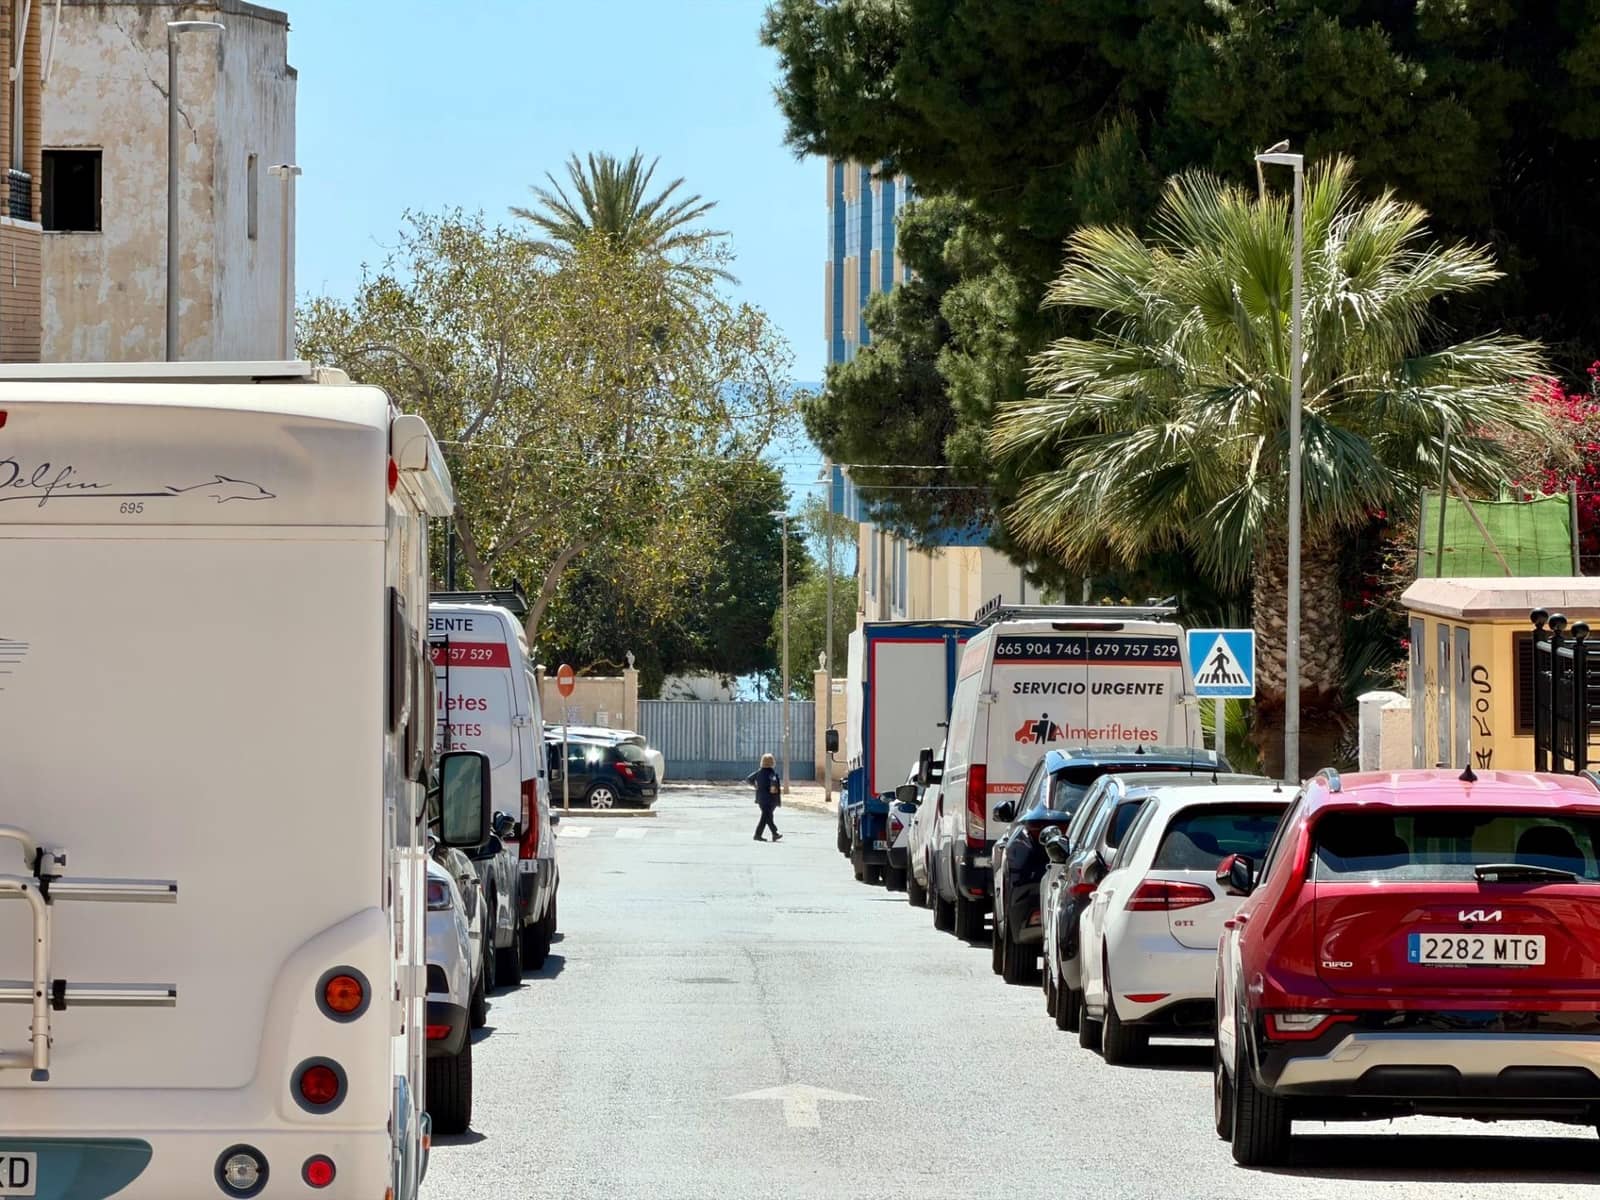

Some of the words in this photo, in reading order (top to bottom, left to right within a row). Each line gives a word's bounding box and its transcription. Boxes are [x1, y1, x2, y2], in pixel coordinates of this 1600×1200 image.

[119, 502, 144, 514] 695
[448, 648, 466, 660] 57
[470, 649, 493, 660] 529
[997, 643, 1022, 655] 665
[1026, 643, 1051, 656] 904
[1056, 643, 1081, 656] 746
[1094, 644, 1120, 656] 679
[1124, 645, 1148, 657] 757
[1153, 645, 1178, 657] 529
[1012, 682, 1086, 695] SERVICIO
[1092, 683, 1164, 695] URGENTE
[1054, 722, 1158, 741] Almerifletes
[1458, 909, 1502, 922] KIA
[1174, 919, 1194, 927] GTI
[1425, 938, 1484, 960] 2282
[1494, 938, 1538, 961] MTG
[0, 1157, 29, 1188] D
